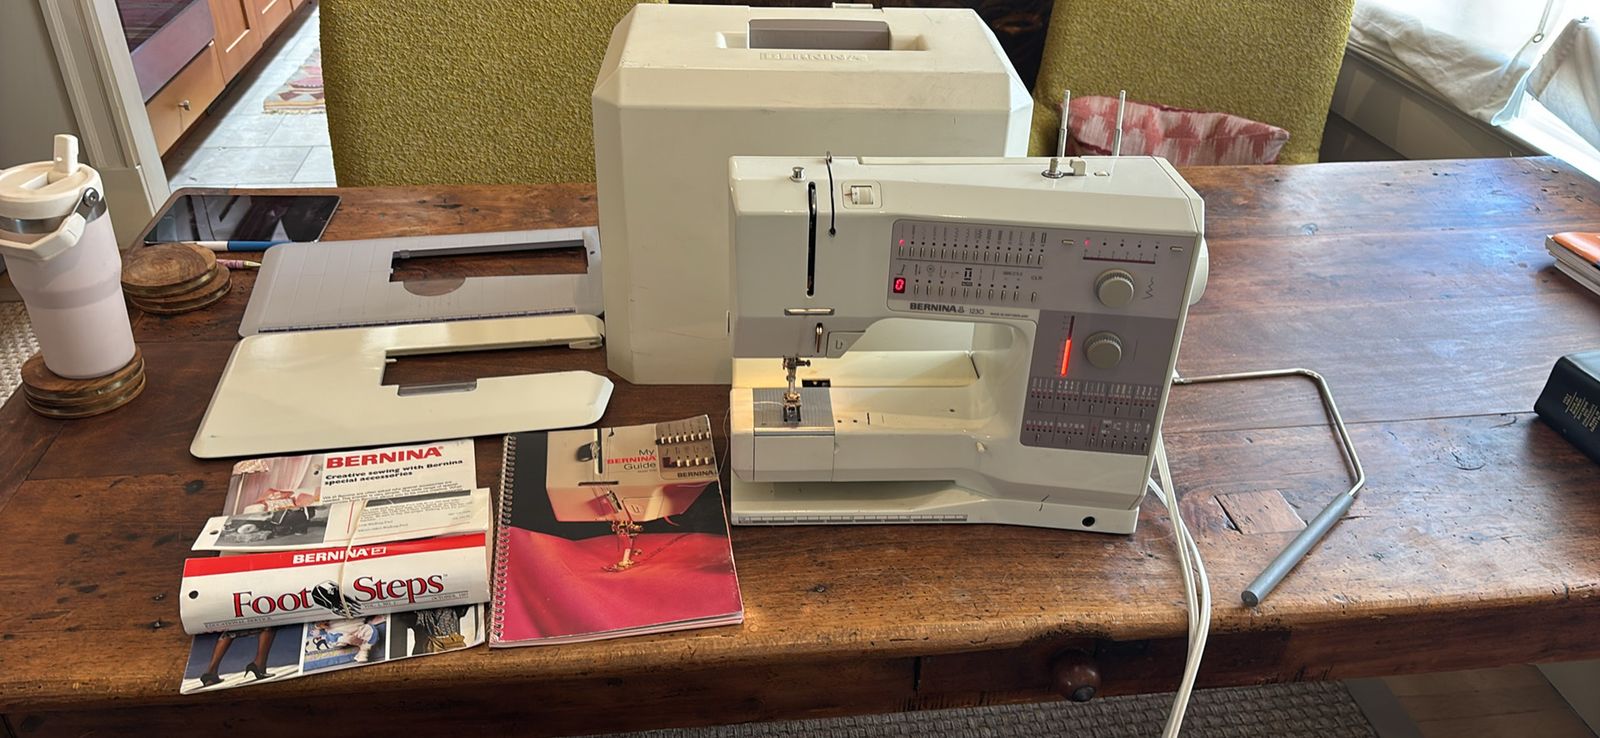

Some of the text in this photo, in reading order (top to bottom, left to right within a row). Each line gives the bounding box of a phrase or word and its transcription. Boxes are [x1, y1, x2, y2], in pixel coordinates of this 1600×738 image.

[909, 302, 957, 313] BERNINA
[326, 446, 442, 469] BERNINA
[607, 455, 657, 465] BERNINA
[325, 470, 366, 480] Creative
[368, 467, 400, 476] sewing
[426, 459, 463, 469] Bernina
[623, 462, 657, 471] Guide
[677, 470, 714, 478] BERNINA
[325, 471, 413, 486] special accessories
[292, 548, 369, 565] BERNINA
[233, 574, 444, 618] Foot Steps
